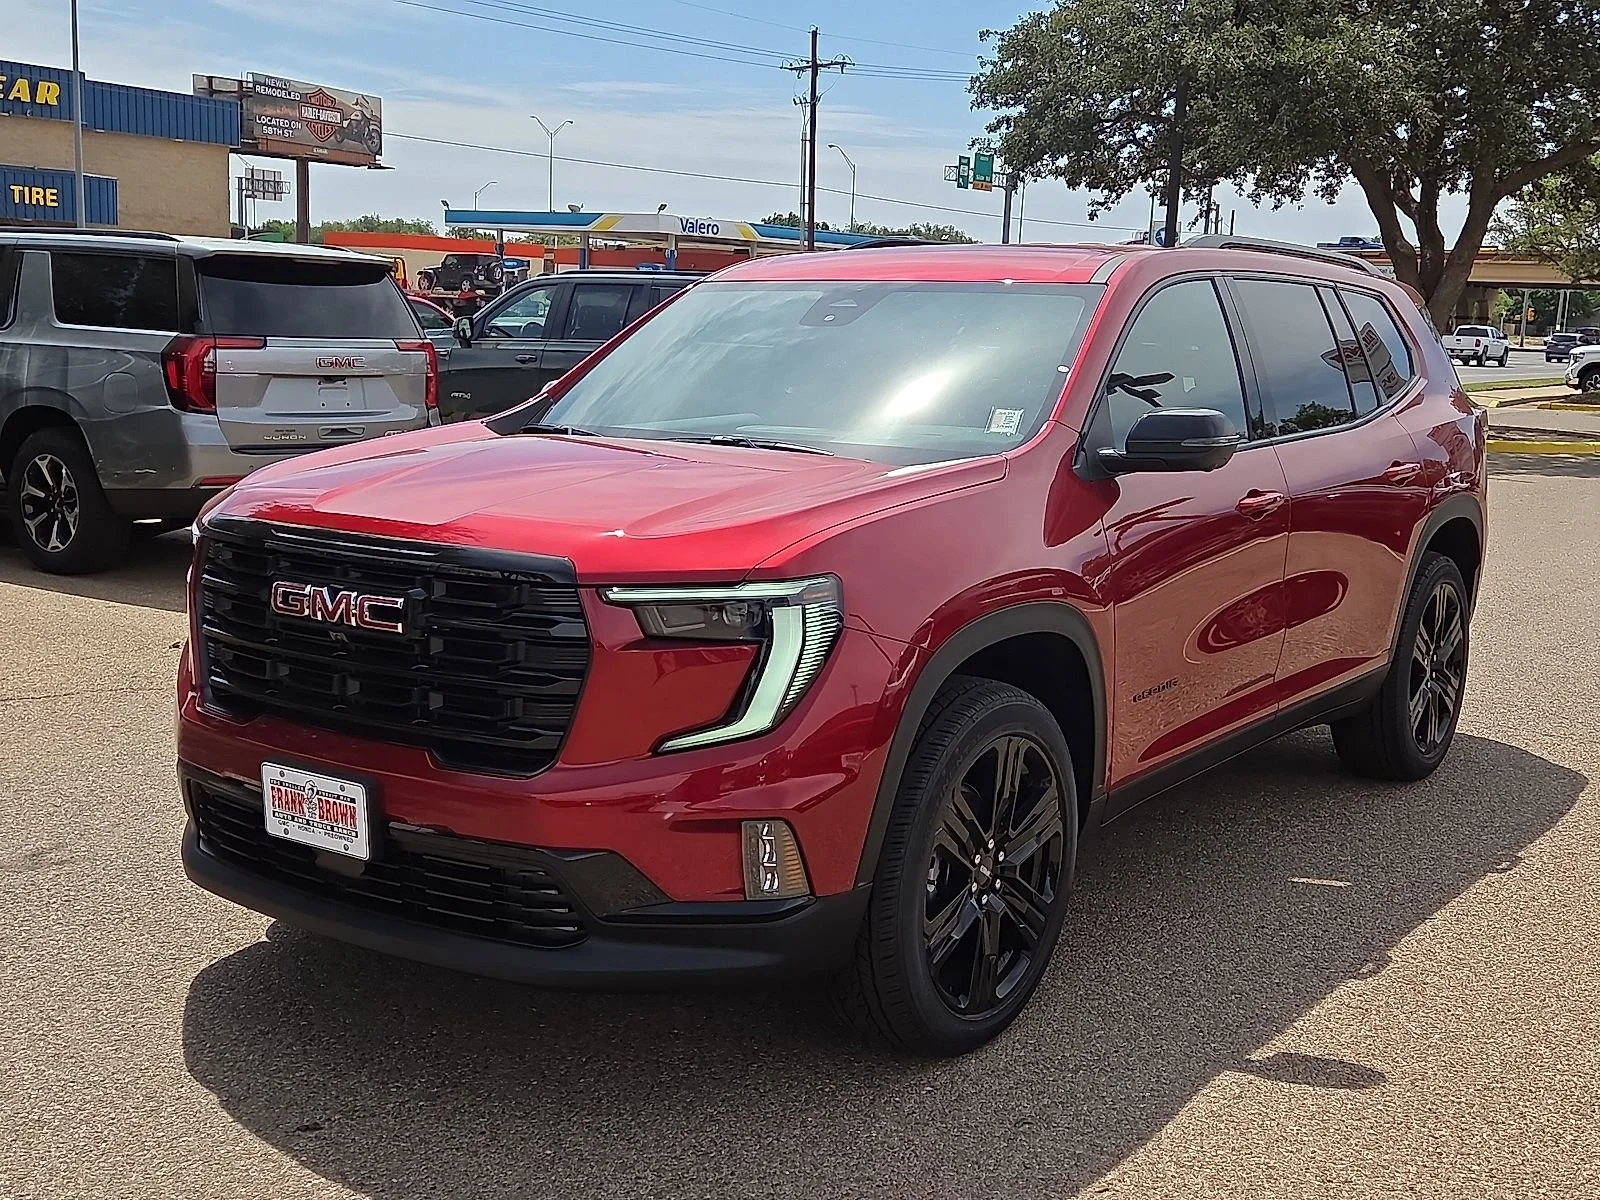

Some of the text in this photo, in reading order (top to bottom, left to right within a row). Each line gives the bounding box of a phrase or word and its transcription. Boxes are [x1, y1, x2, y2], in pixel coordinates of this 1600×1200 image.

[265, 78, 290, 89] NEWLY
[255, 85, 301, 101] REMODELED
[256, 115, 291, 129] LOCATED
[263, 126, 282, 137] 58TH
[10, 185, 59, 207] TIRE
[680, 218, 720, 236] Valero
[315, 356, 367, 369] GMC
[271, 581, 404, 633] GMC
[270, 786, 358, 830] FRANK BROWN
[274, 812, 357, 838] AUTO AND TRUCK RANCH
